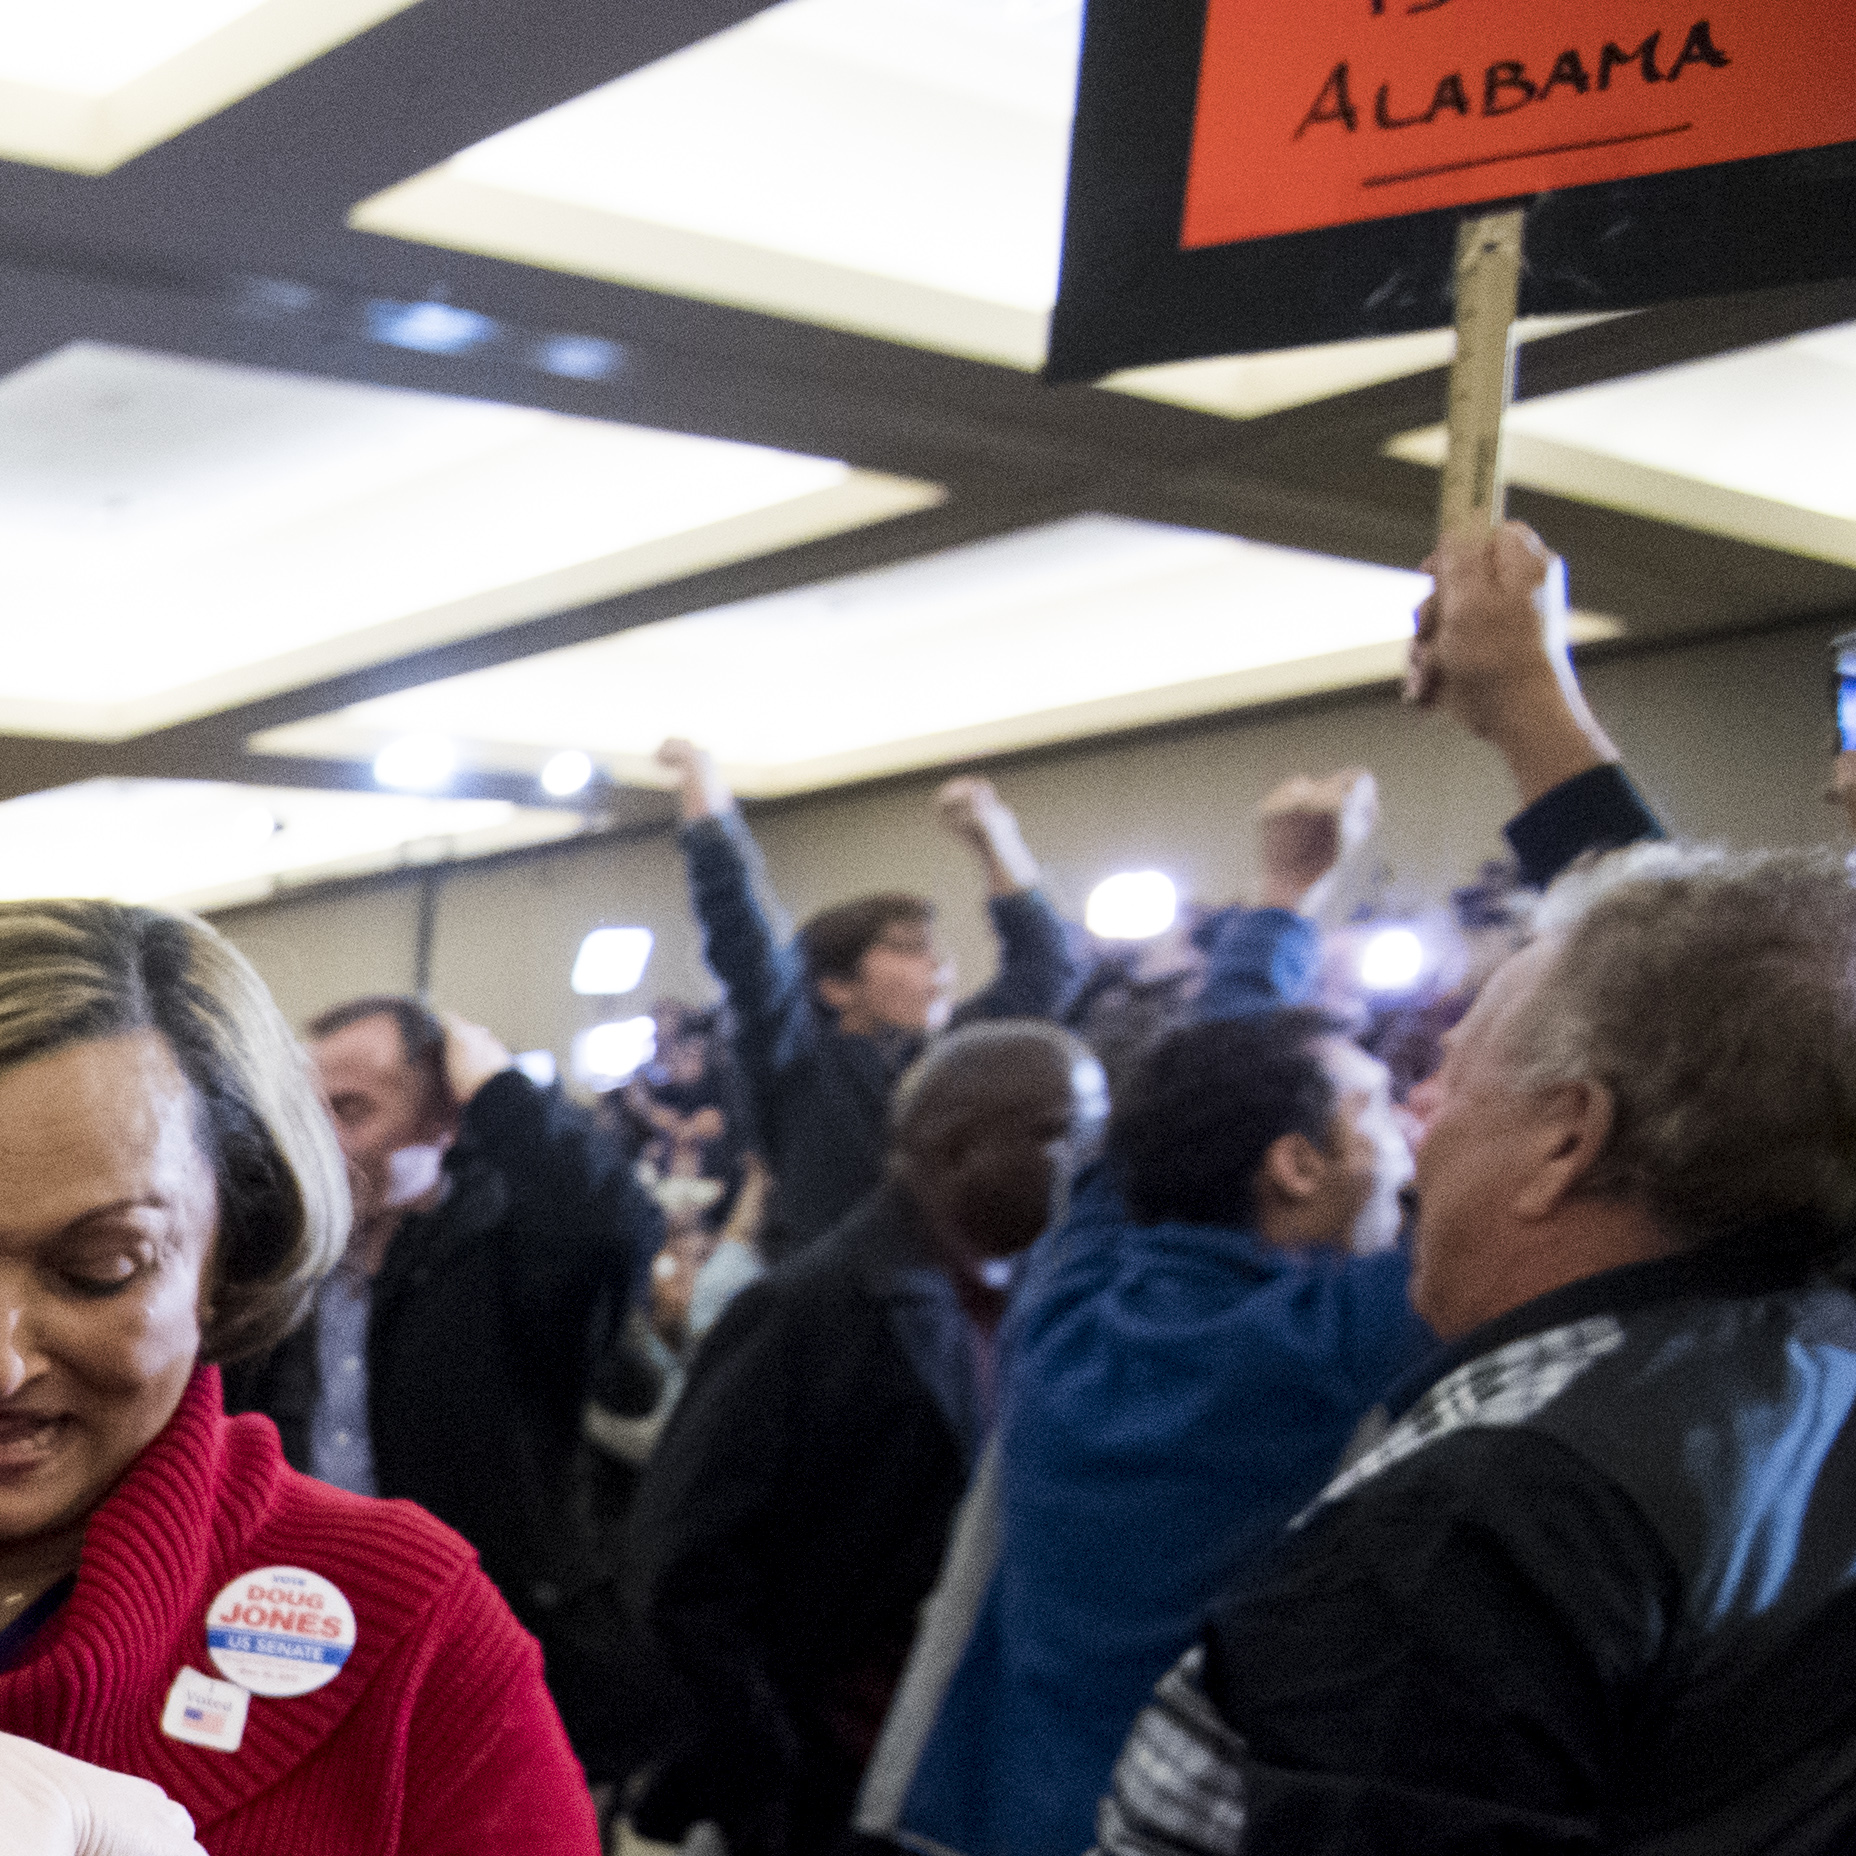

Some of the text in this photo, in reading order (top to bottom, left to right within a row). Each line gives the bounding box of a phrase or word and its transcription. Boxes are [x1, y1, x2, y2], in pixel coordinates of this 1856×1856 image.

[1292, 19, 1733, 142] ALABAMA
[246, 1584, 325, 1610] DOUG
[219, 1602, 343, 1639] JONES
[255, 1639, 325, 1661] SENATE
